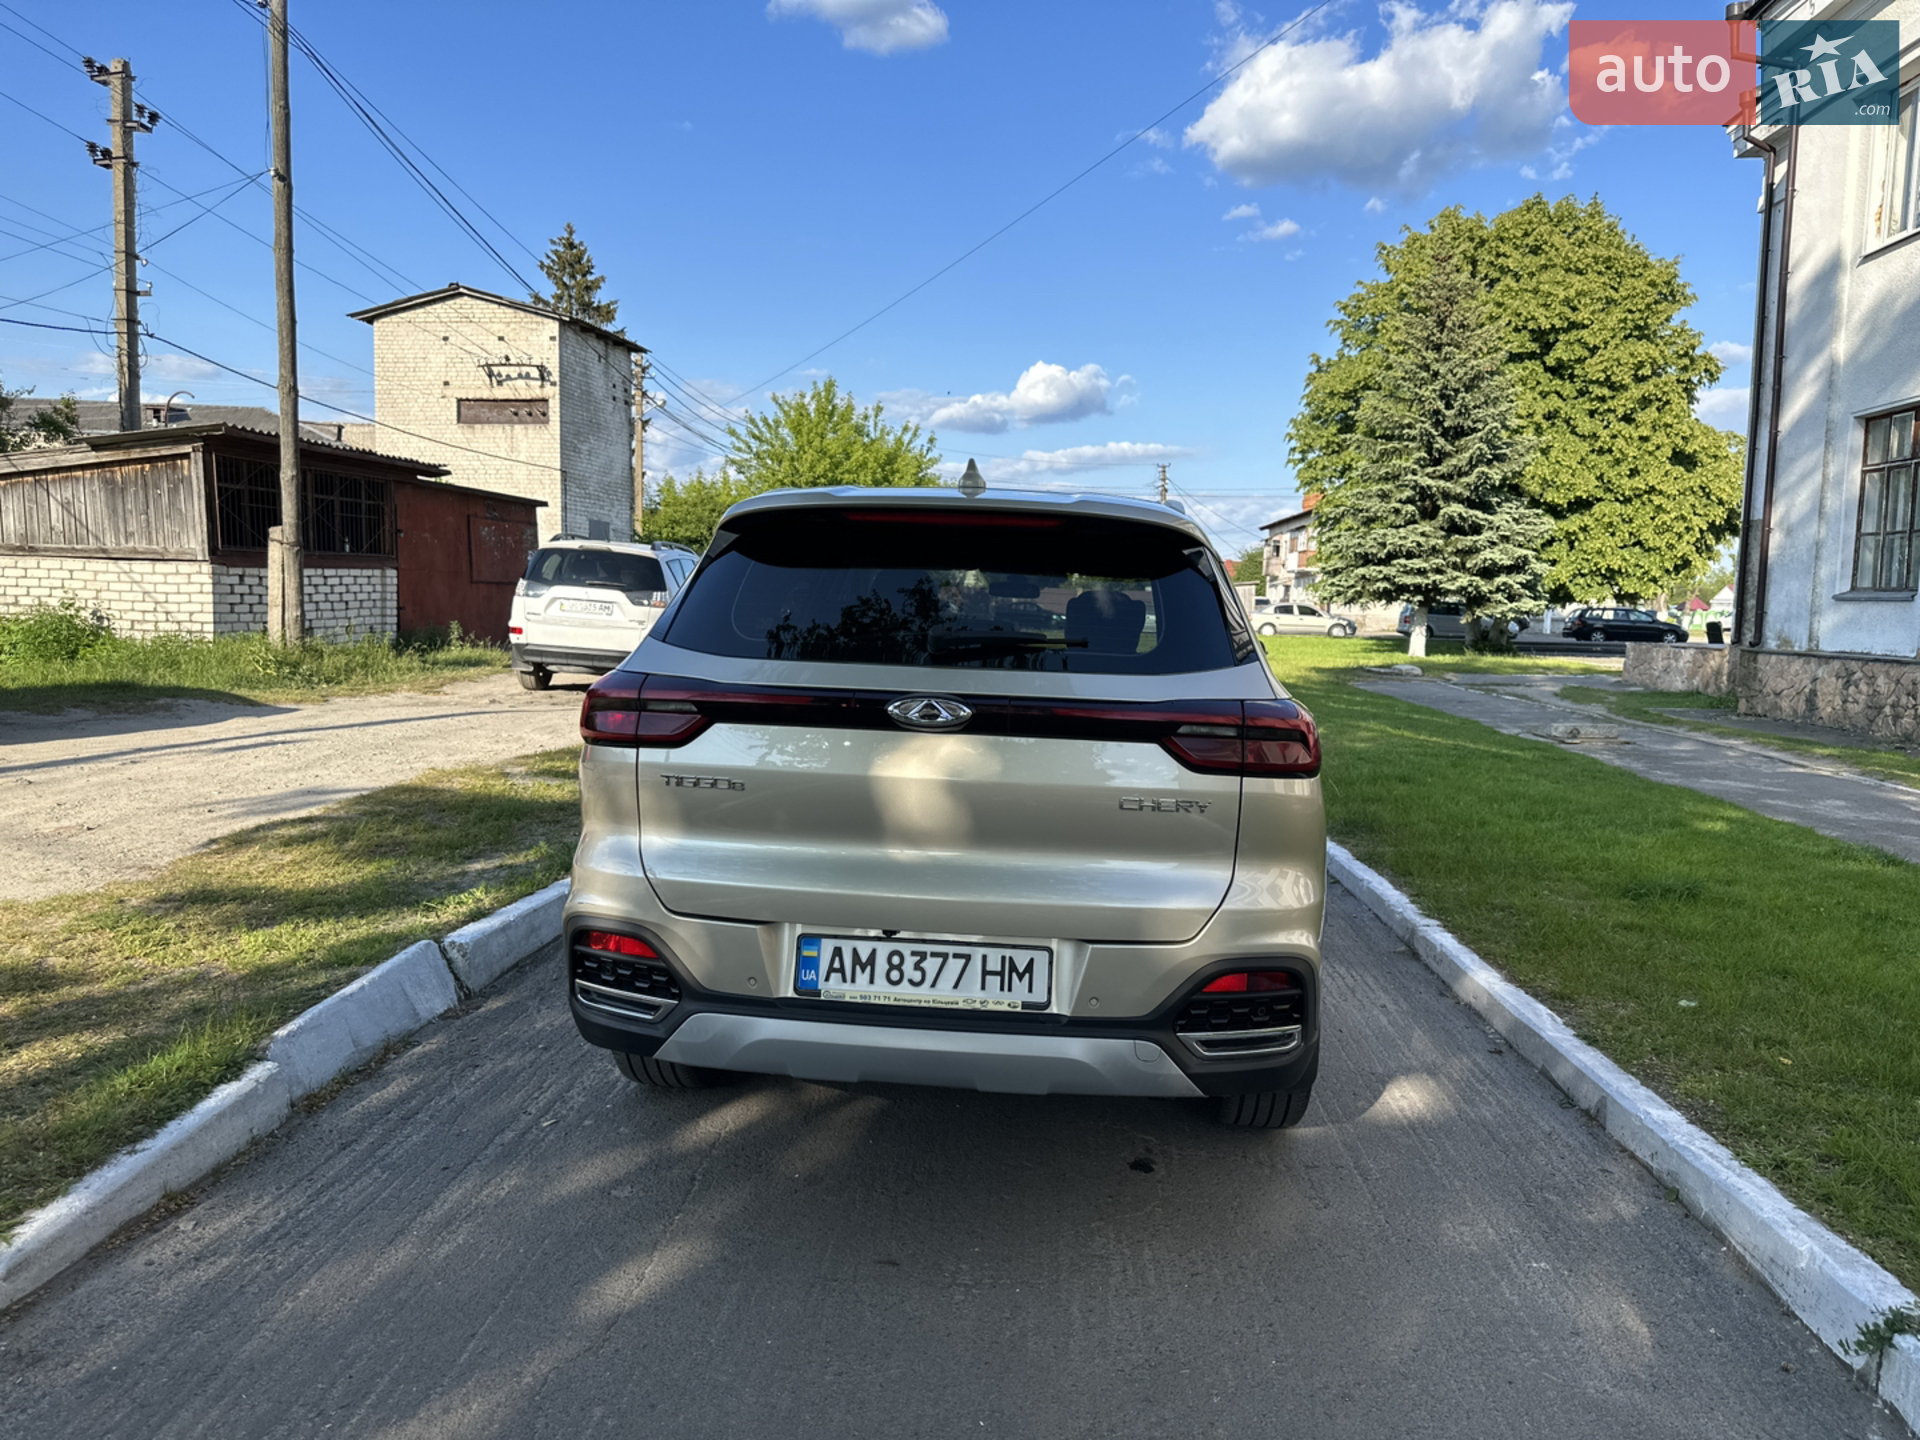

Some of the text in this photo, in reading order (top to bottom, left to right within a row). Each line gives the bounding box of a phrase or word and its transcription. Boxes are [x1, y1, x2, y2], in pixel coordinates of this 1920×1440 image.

[1119, 796, 1212, 813] CHERY
[801, 969, 817, 981] UA
[824, 946, 1035, 994] AM 8377 HM
